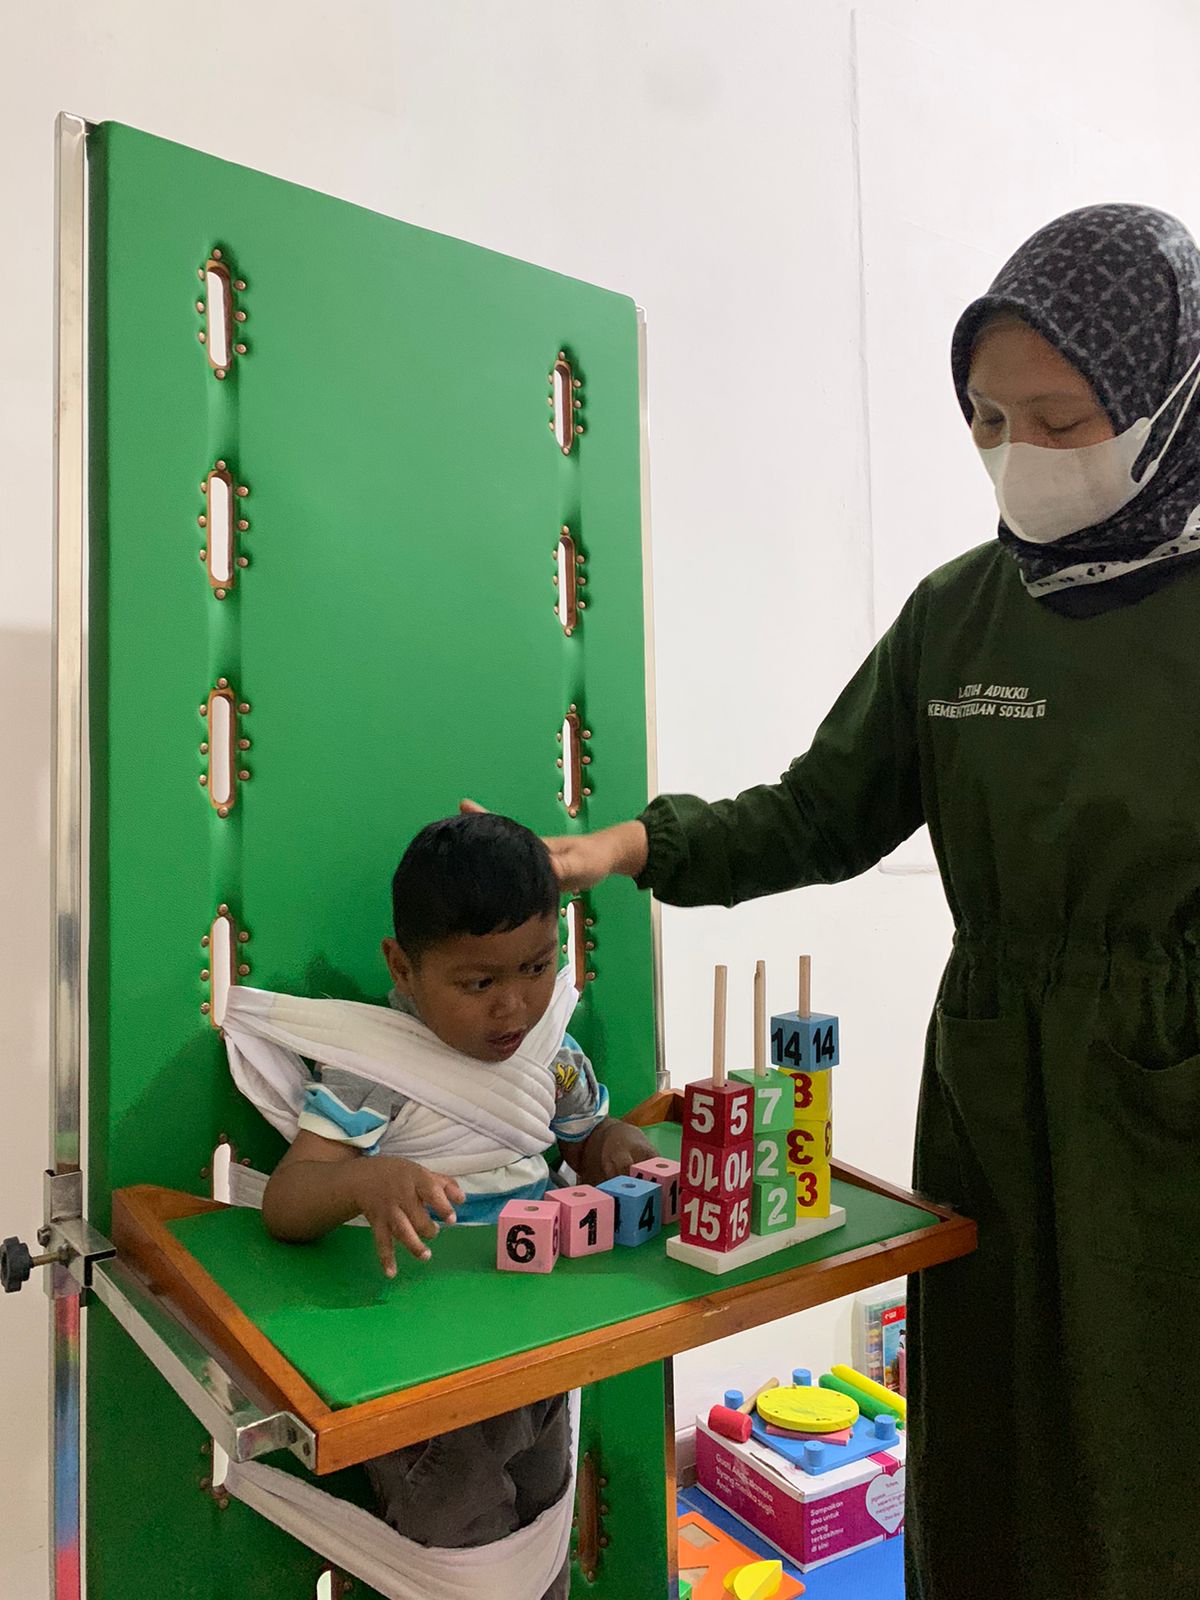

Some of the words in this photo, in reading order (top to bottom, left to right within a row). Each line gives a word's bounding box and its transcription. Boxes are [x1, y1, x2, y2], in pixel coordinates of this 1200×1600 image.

[928, 703, 996, 718] KEMENTERIAN
[999, 705, 1034, 718] SOSIAL
[958, 684, 982, 698] LATIH
[984, 685, 1029, 699] ADIKKU
[771, 1027, 802, 1066] 14
[812, 1025, 835, 1063] 14
[690, 1093, 715, 1133] 5
[730, 1095, 748, 1136] 5
[757, 1088, 782, 1125] 7
[757, 1140, 779, 1176] 2
[786, 1129, 814, 1165] 3
[768, 1187, 788, 1226] 2
[797, 1171, 818, 1207] 3
[579, 1208, 597, 1246] 1
[639, 1196, 655, 1232] 4
[684, 1197, 721, 1242] 15
[729, 1198, 749, 1241] 15
[506, 1224, 536, 1263] 6
